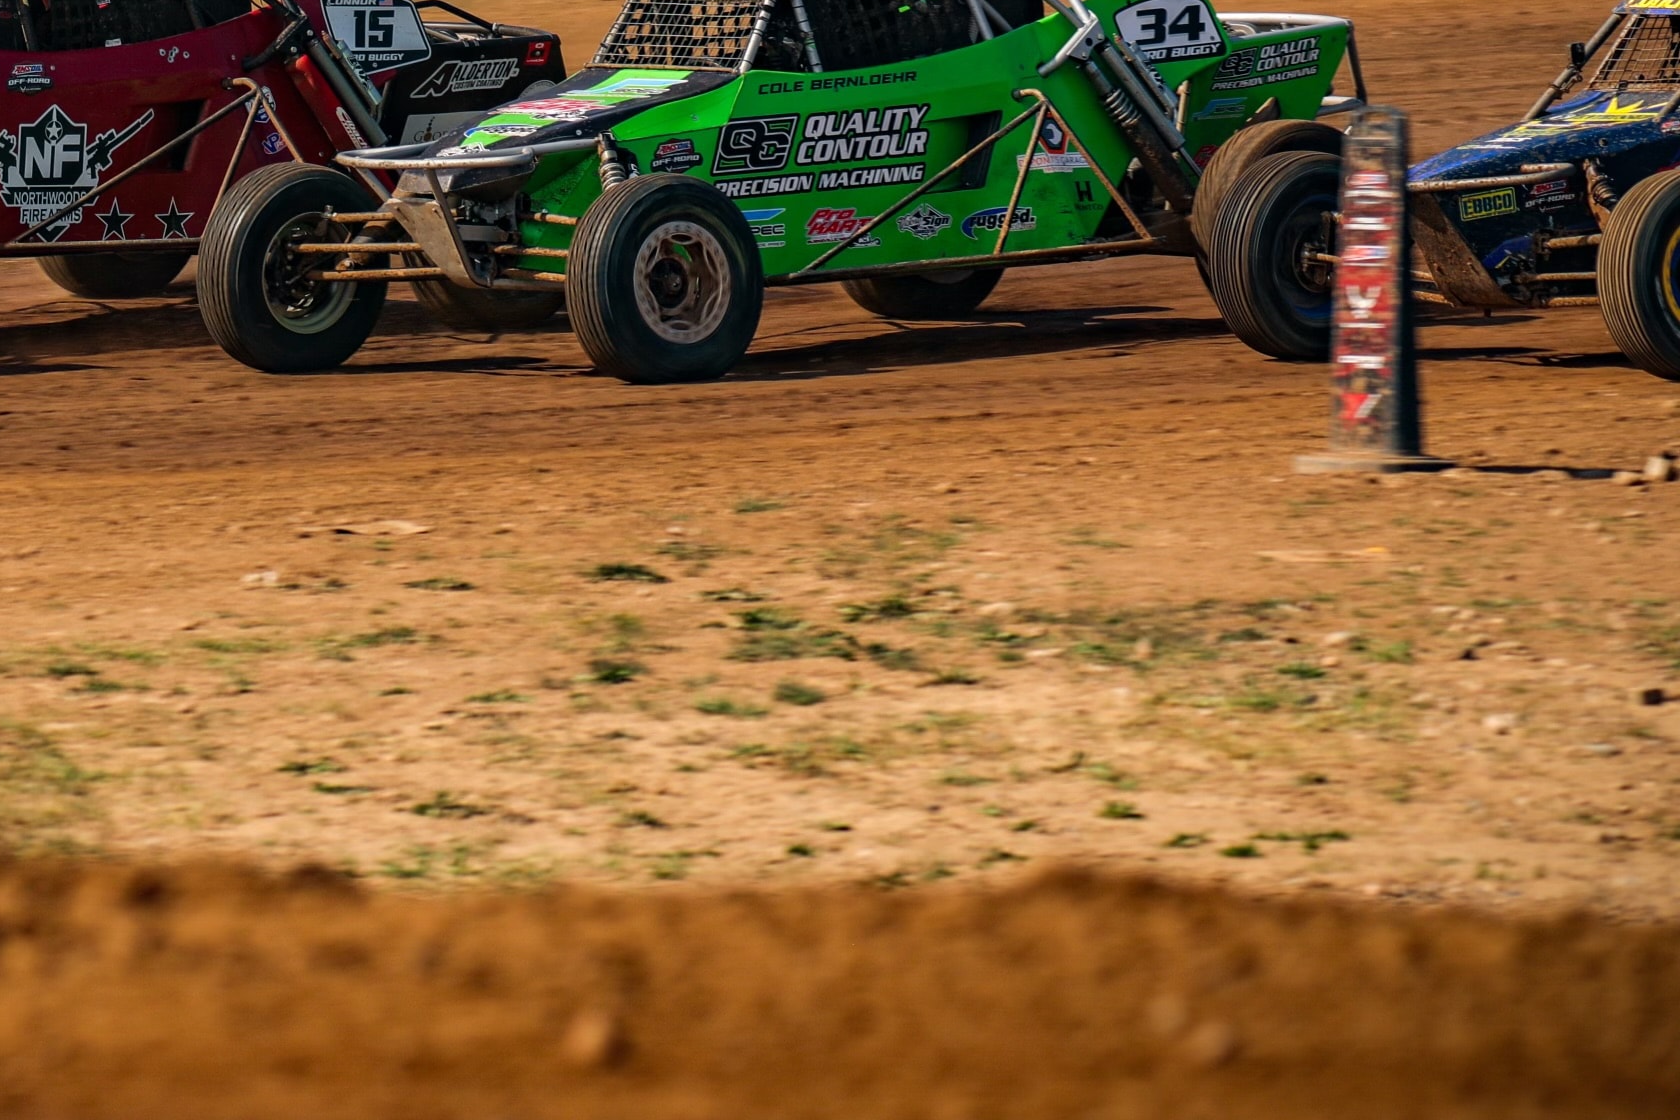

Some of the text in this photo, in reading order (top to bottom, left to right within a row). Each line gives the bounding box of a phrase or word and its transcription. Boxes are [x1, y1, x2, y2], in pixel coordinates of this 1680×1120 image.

[353, 10, 395, 48] 15
[1136, 5, 1206, 46] 34
[350, 53, 404, 62] RO BUGGY
[1145, 43, 1220, 60] RO BUGGY
[1260, 37, 1319, 58] QUALITY
[1257, 49, 1319, 71] CONTOUR
[758, 71, 917, 95] COLE BERNLOEHR
[804, 106, 928, 138] QUALITY
[24, 134, 81, 179] NF
[796, 131, 926, 164] CONTOUR
[716, 165, 924, 197] PRECISION MACHINING
[1462, 192, 1513, 216] EBBCO
[807, 208, 856, 227] Pro
[751, 224, 785, 236] PEC
